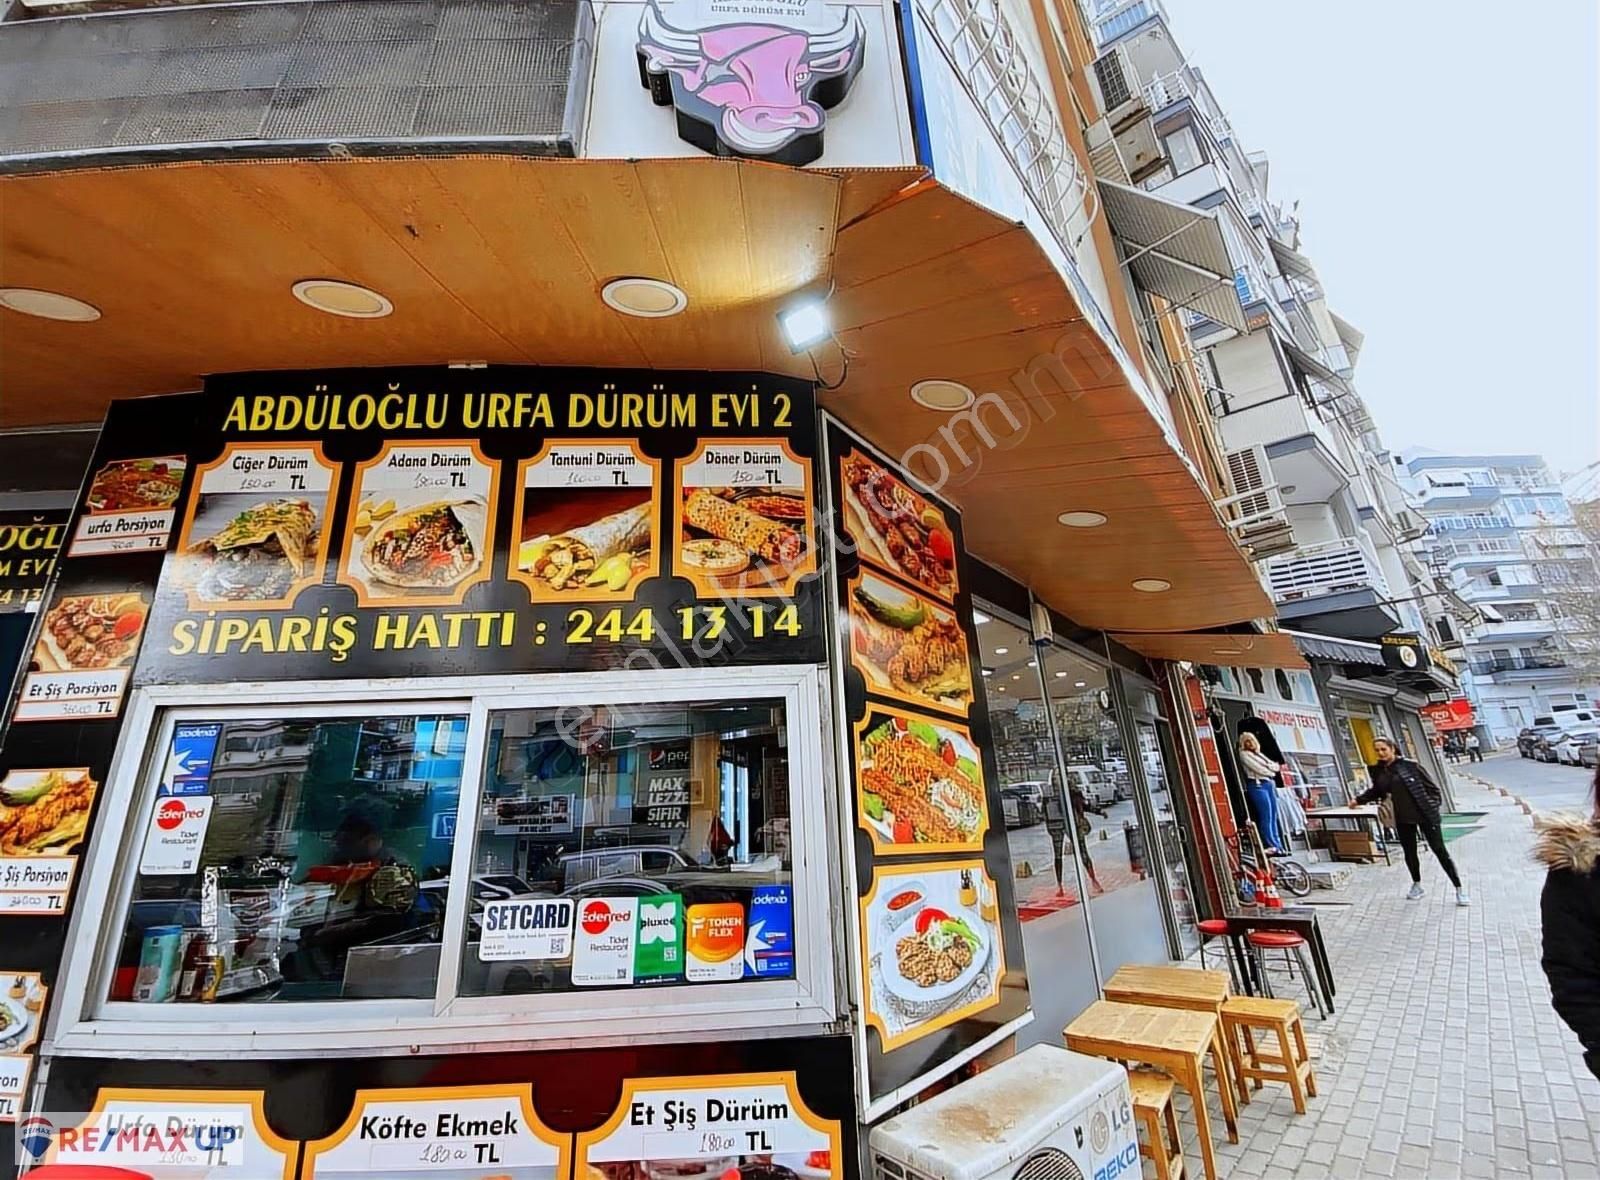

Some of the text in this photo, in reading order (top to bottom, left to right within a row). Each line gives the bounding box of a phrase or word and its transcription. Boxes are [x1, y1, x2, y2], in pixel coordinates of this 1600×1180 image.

[222, 382, 792, 431] ABDÜLOĞLU URFA DÜRÜM EVİ 2
[232, 455, 308, 473] Ciğer Dürüm
[388, 453, 471, 467] Adana Dürüm
[550, 452, 635, 466] Tantuni Dürüm
[706, 451, 782, 464] Döner Dürüm
[290, 474, 306, 490] TL
[450, 472, 466, 487] TL
[612, 471, 629, 485] TL
[765, 470, 782, 484] TL
[115, 517, 165, 534] Porsiyon
[147, 536, 162, 547] TL
[168, 606, 357, 662] SİPARİŞ
[373, 611, 516, 651] HATTI
[566, 607, 656, 645] 244
[677, 605, 727, 641] 13
[747, 603, 803, 639] 14
[29, 681, 117, 699] Et Şiş Porsiyon
[98, 701, 112, 713] TL
[648, 777, 684, 792] MAX
[157, 807, 205, 820] Edenred
[23, 865, 69, 887] Porsiyon
[48, 895, 62, 910] TL
[753, 892, 788, 905] odexo
[486, 904, 571, 931] SETCARD
[582, 910, 632, 922] Edenred
[708, 917, 742, 928] TOKEN
[708, 928, 734, 937] FLEX
[631, 1098, 788, 1132] Et Şiş Dürüm
[1111, 1100, 1130, 1132] LG
[106, 1114, 245, 1140] Urfa Dürüm
[360, 1111, 518, 1140] Köfte Ekmek
[745, 1131, 772, 1151] TL
[206, 1149, 228, 1166] TL
[474, 1143, 500, 1163] TL
